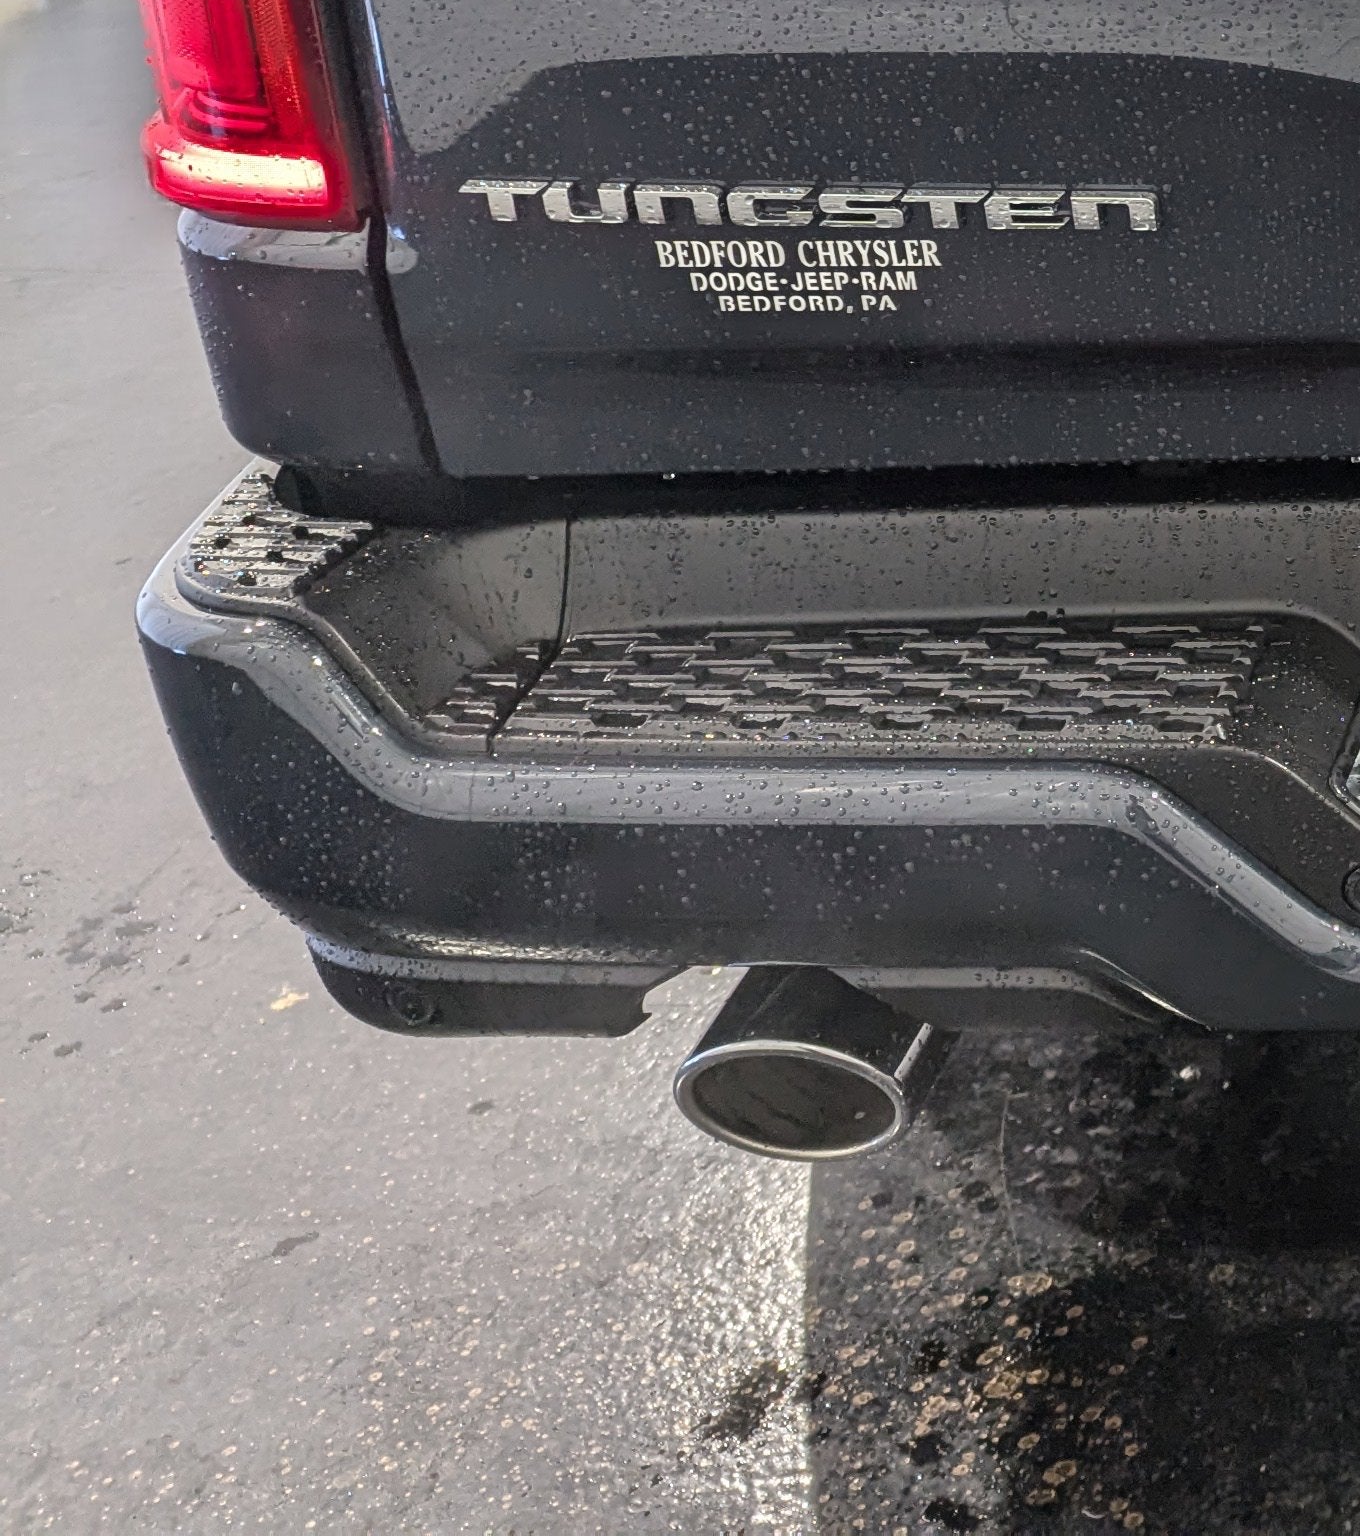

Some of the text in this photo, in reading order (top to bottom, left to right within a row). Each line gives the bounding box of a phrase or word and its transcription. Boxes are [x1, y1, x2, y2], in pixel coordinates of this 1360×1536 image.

[655, 239, 942, 268] BEDFORD CHRYSLER
[718, 294, 897, 314] BEDFORD, PA
